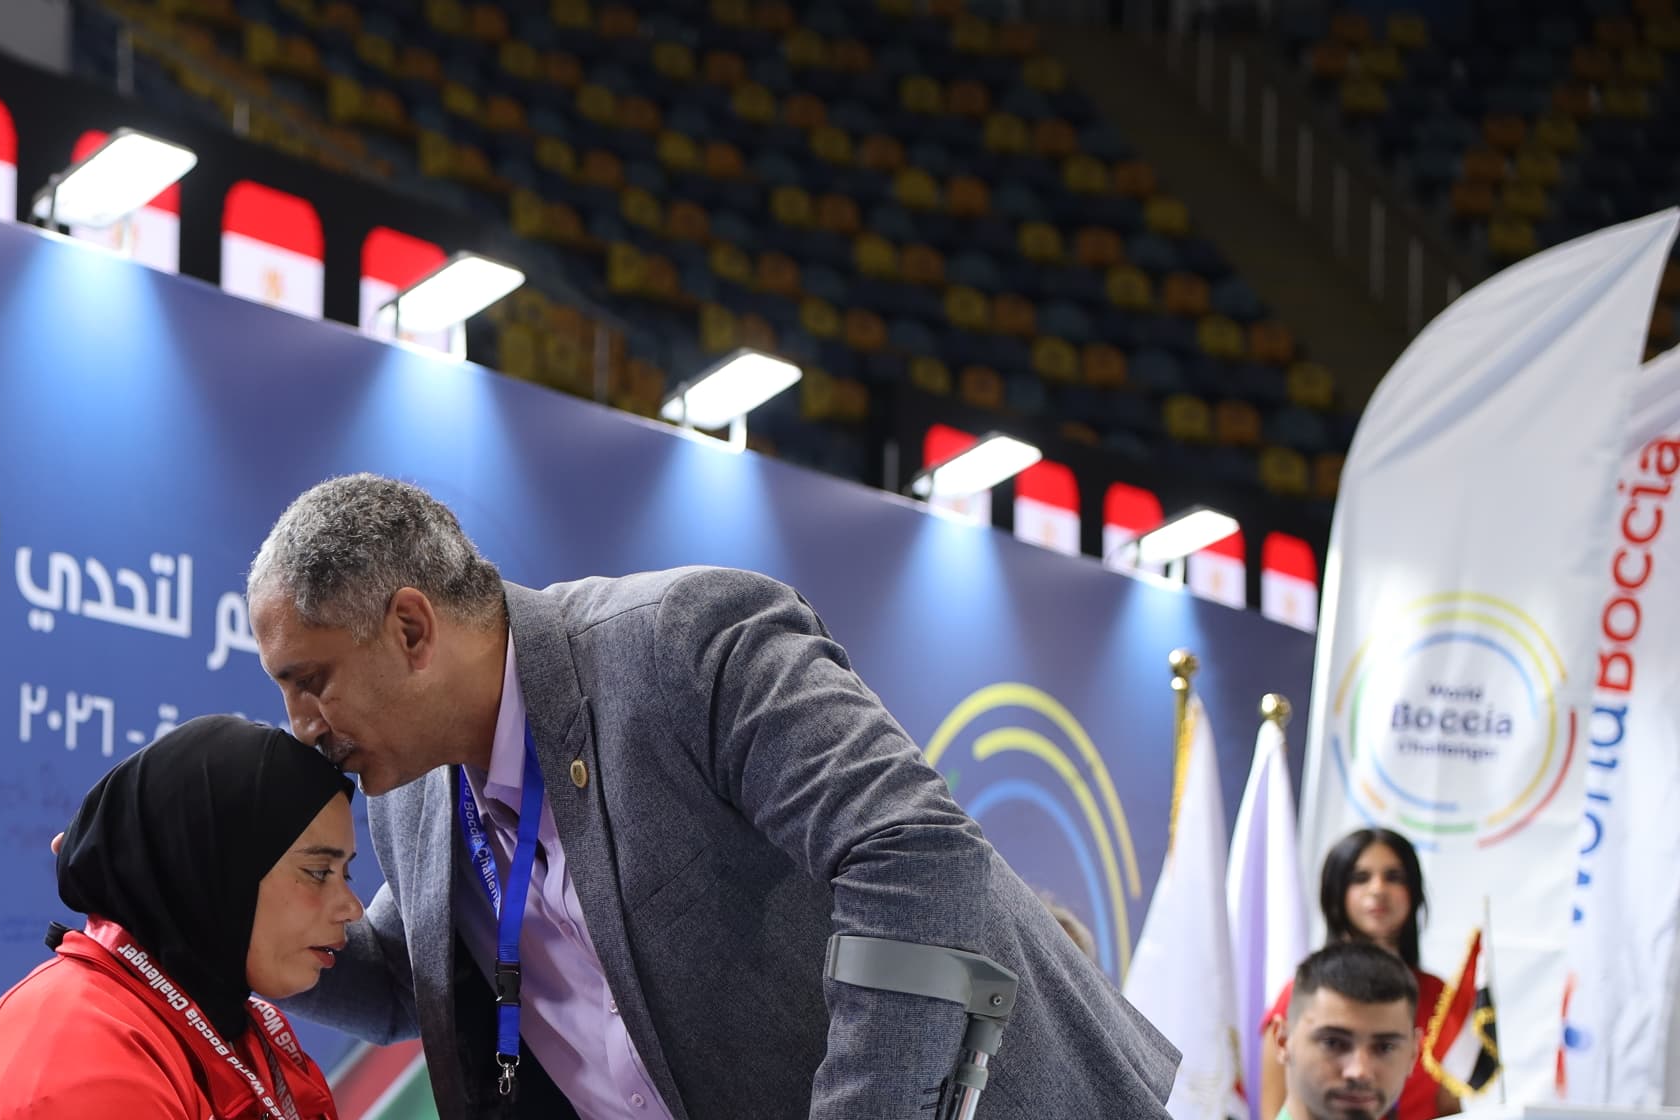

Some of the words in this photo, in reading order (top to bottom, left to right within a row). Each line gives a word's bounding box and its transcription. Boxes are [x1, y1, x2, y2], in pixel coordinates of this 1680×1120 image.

[17, 546, 193, 639] لتحدي
[20, 683, 114, 756] ٢٠٢٦
[1392, 701, 1513, 736] Boccia
[463, 801, 481, 847] Boccia
[117, 943, 190, 1011] Challenger
[184, 1009, 229, 1056] Boccia
[226, 1055, 266, 1095] World
